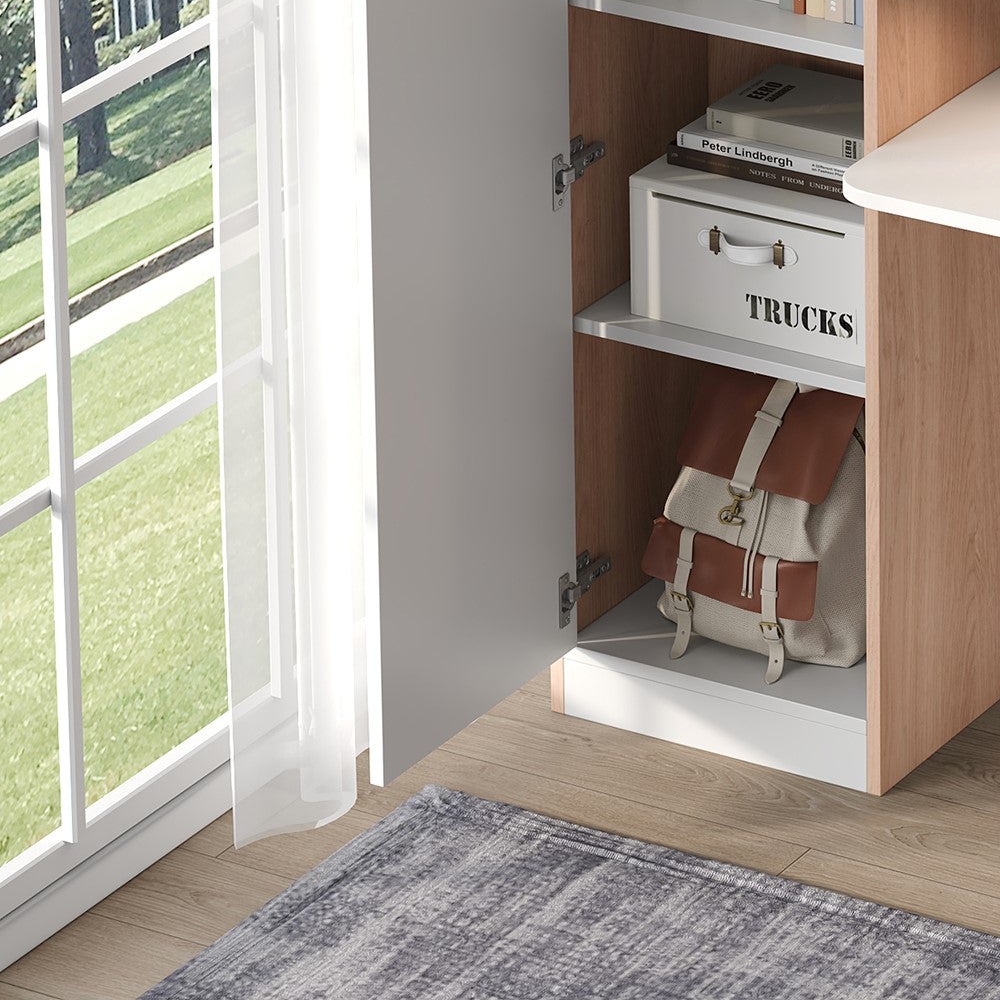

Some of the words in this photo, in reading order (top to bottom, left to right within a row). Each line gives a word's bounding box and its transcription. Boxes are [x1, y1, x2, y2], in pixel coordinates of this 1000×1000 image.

[702, 139, 732, 154] Peter
[734, 146, 793, 168] Lindbergh
[749, 168, 776, 180] NOTES
[781, 175, 805, 186] FROM
[745, 293, 854, 339] TRUCKS
